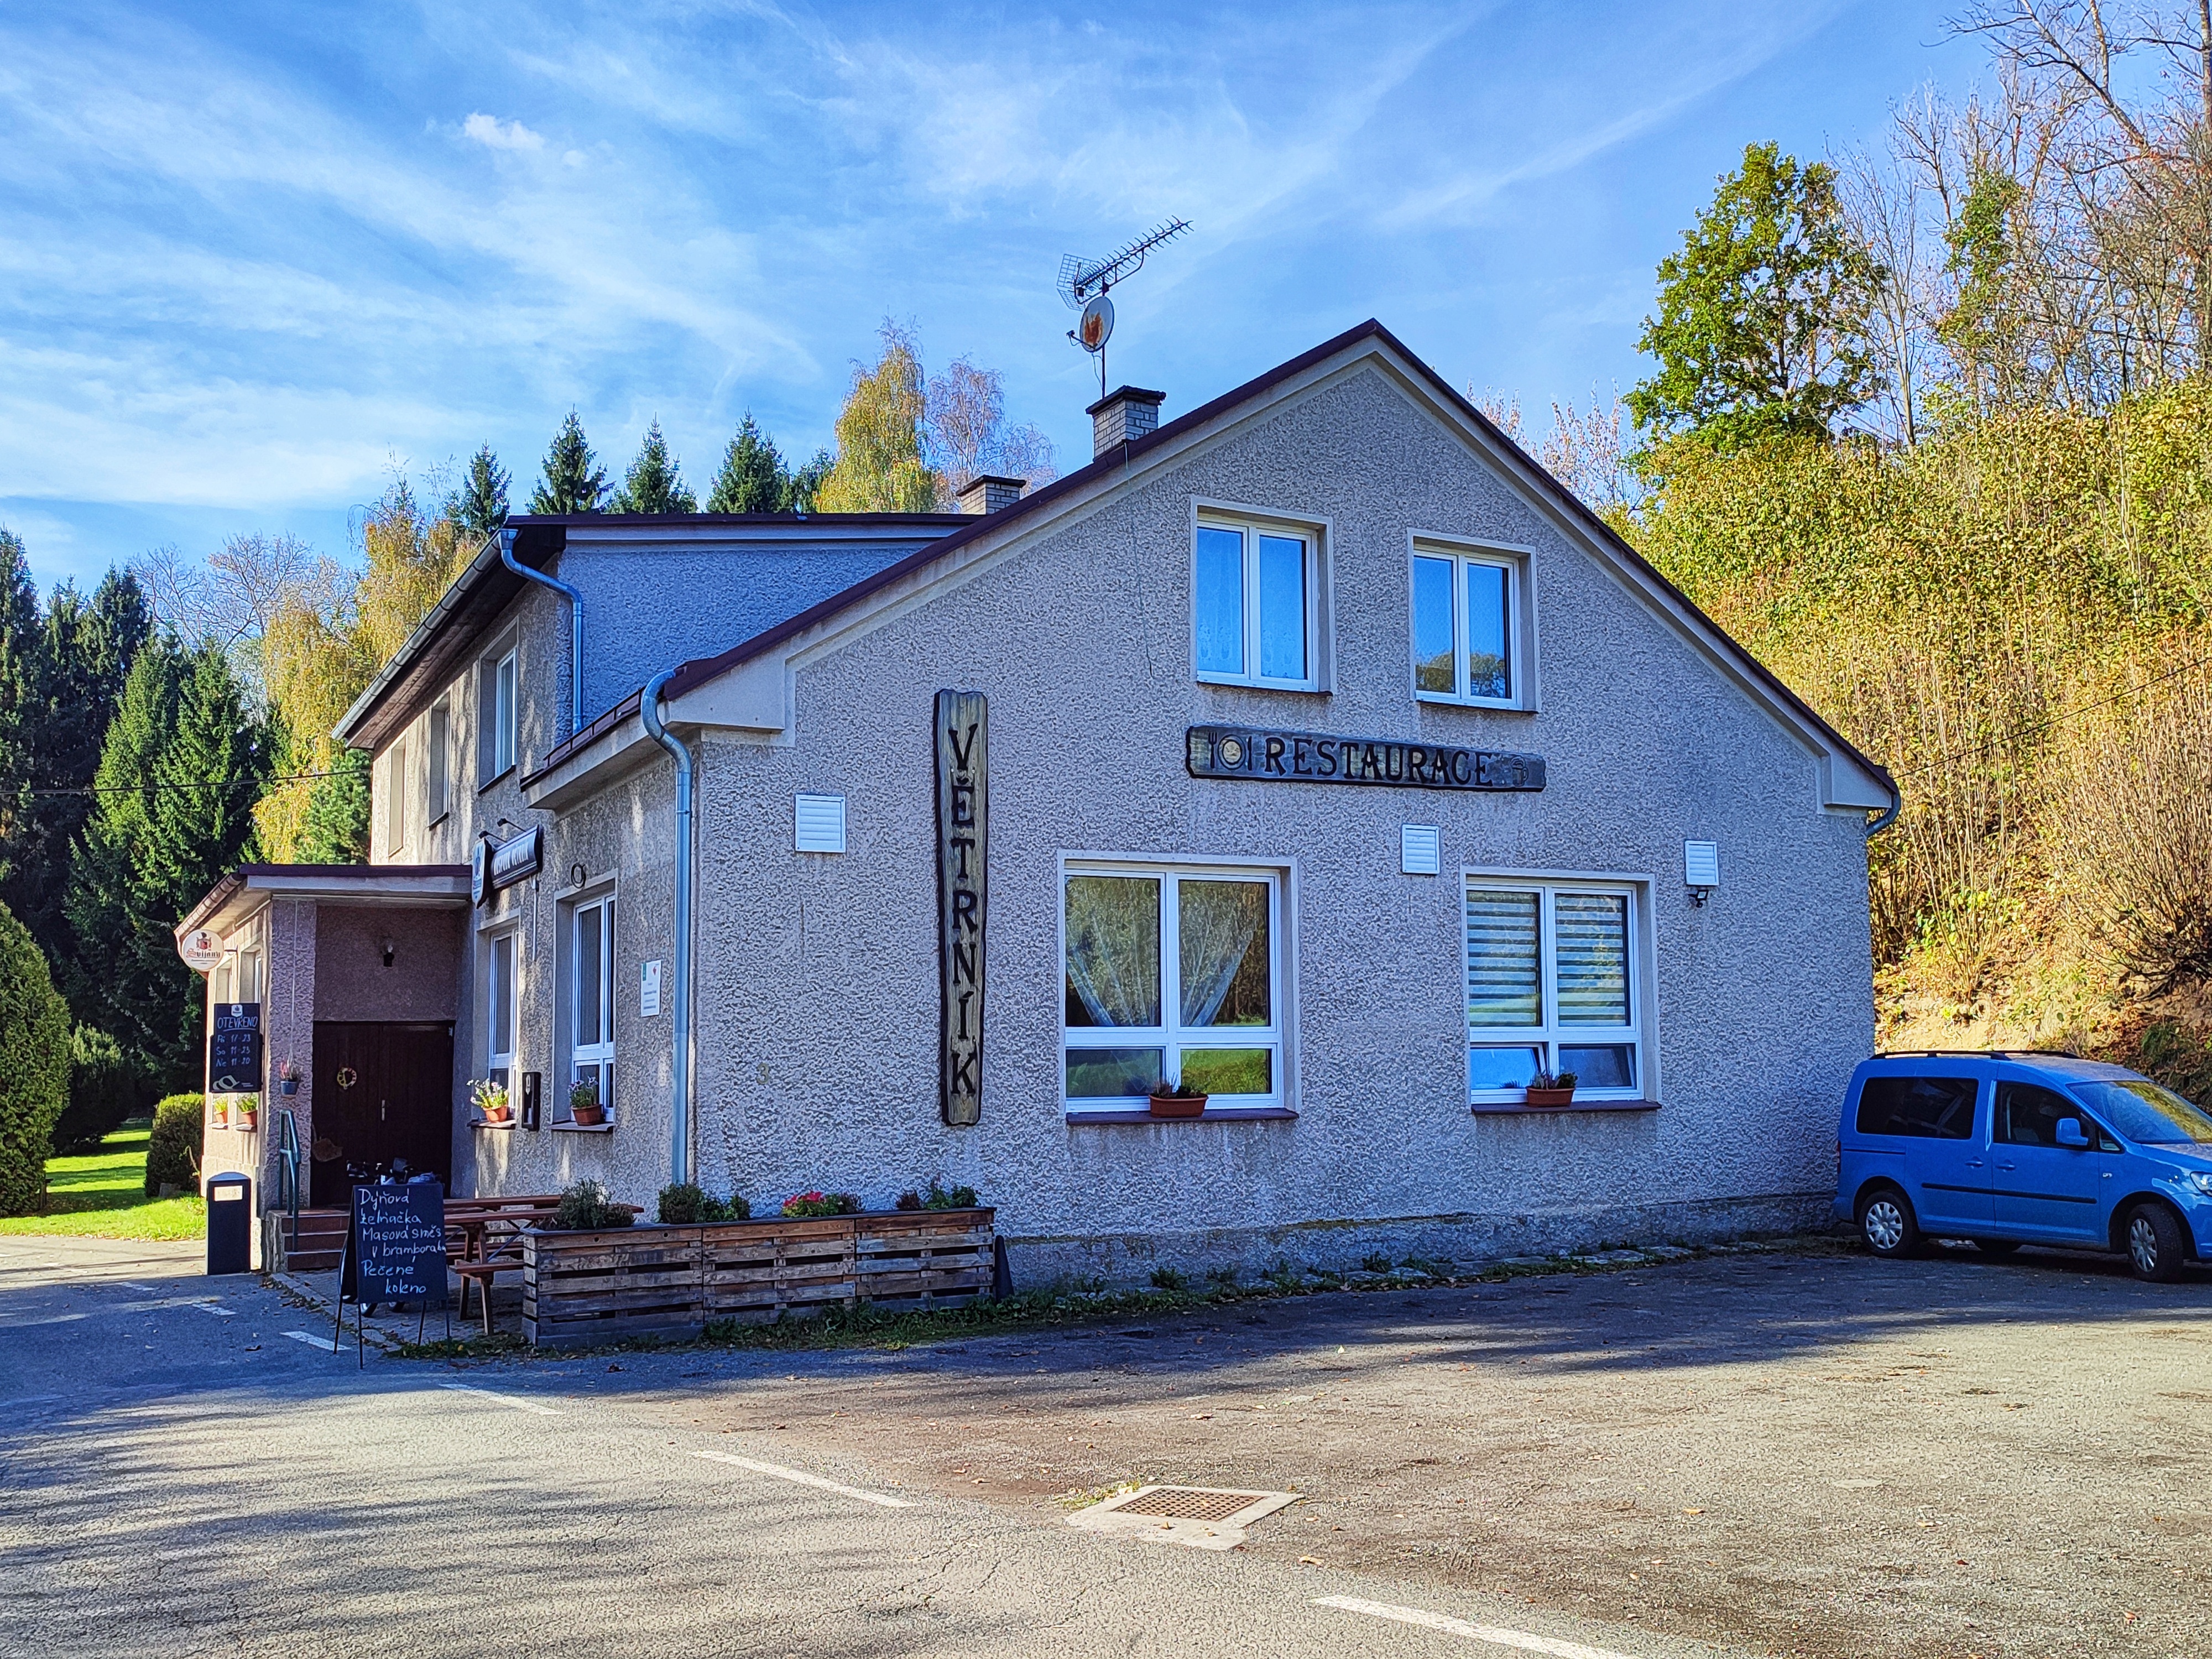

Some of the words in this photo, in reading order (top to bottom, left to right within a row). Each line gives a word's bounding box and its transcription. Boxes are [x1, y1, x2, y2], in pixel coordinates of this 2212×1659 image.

[1265, 737, 1493, 786] RESTAURACE
[948, 724, 978, 1096] VĚTRNÍK
[217, 1014, 258, 1029] OTEVŘENO
[755, 1062, 770, 1084] 3
[358, 1188, 409, 1211] Dýňová
[363, 1225, 409, 1241] Masová
[412, 1224, 441, 1239] směs
[361, 1255, 416, 1277] Pečené
[385, 1278, 426, 1295] koleno
